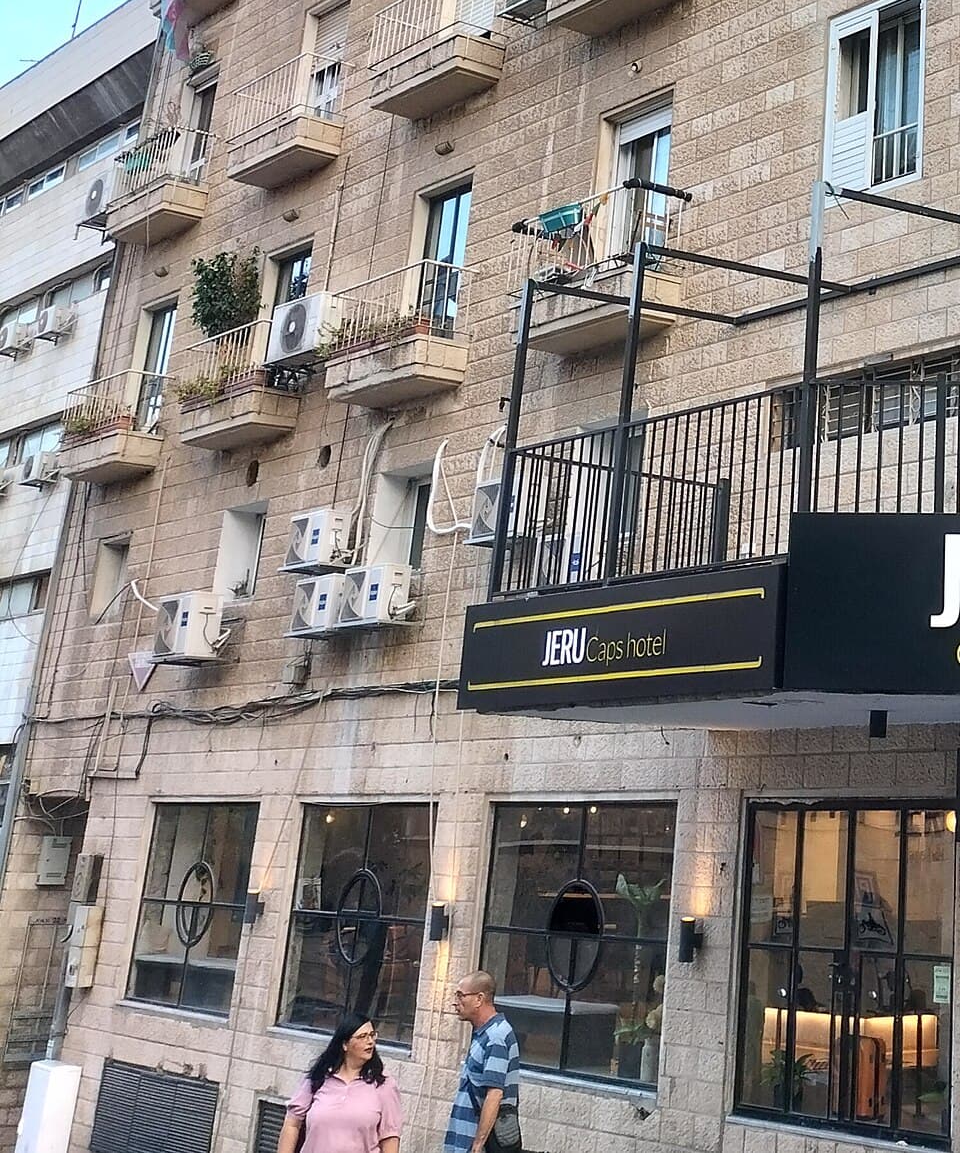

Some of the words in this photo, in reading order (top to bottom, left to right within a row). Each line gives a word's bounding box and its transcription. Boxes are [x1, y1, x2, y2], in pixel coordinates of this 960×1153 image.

[542, 627, 587, 666] JERU
[586, 636, 624, 666] Caps
[627, 628, 667, 658] hotel
